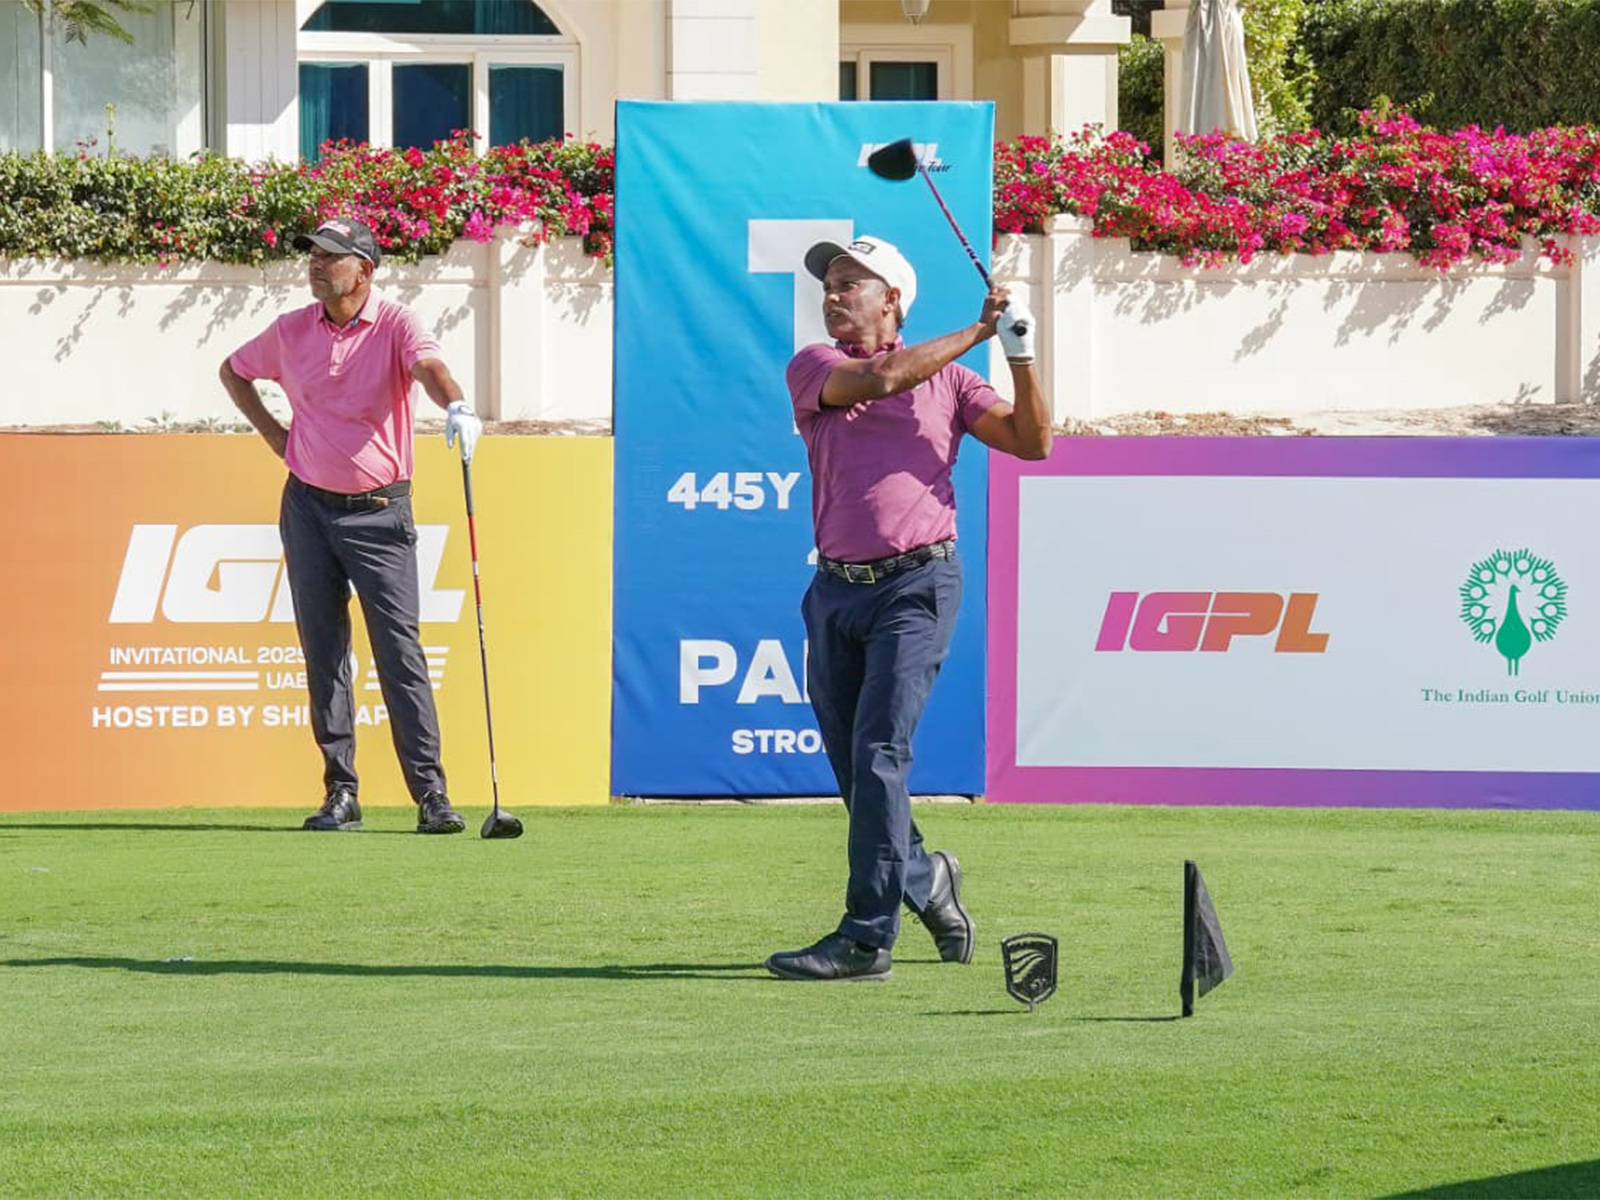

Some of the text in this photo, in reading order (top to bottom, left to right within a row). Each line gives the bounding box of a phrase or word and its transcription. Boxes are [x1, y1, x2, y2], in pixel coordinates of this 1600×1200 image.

[667, 472, 801, 510] 445Y
[108, 524, 465, 623] IGL
[1095, 592, 1330, 653] IGPL
[110, 647, 252, 665] INVITATIONAL
[680, 639, 811, 704] PA
[1421, 689, 1451, 702] The
[1457, 689, 1509, 703] Indian
[1514, 690, 1549, 703] Golf
[92, 706, 209, 727] HOSTED
[217, 706, 254, 727] BY
[731, 729, 826, 754] STRO
